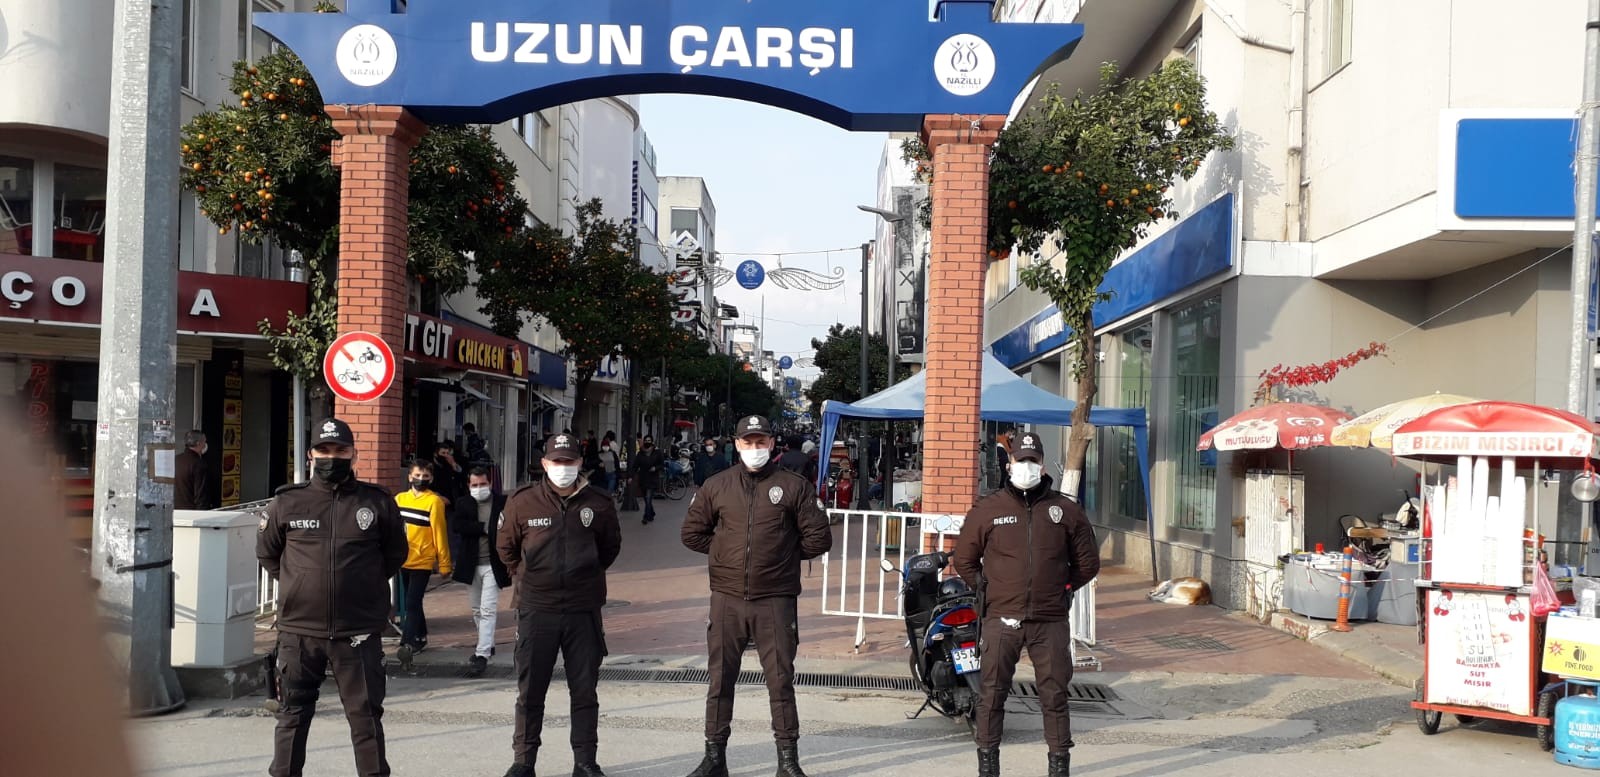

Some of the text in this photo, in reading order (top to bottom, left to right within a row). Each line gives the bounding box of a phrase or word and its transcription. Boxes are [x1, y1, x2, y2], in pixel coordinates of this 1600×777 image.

[471, 22, 853, 76] UZUN ÇARŞI
[459, 337, 504, 370] CHICKEN
[955, 651, 968, 661] 35
